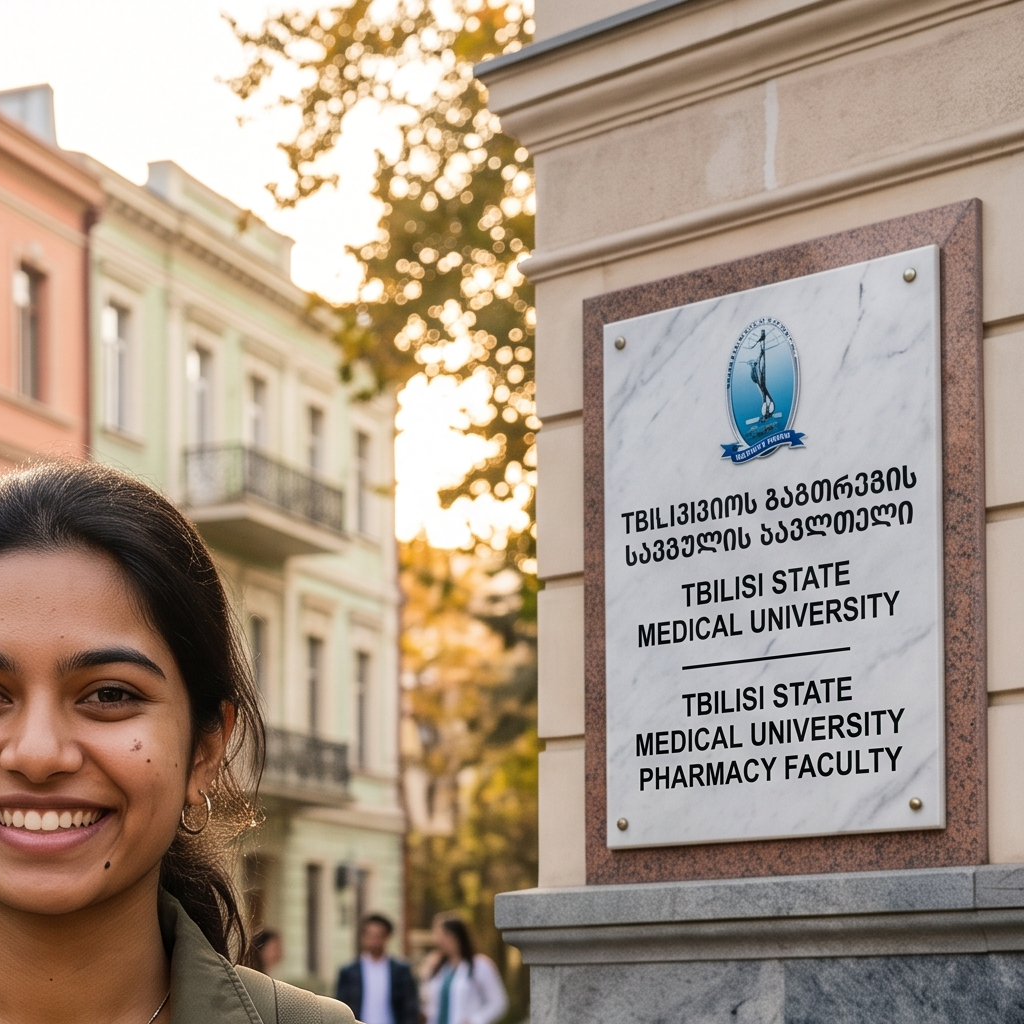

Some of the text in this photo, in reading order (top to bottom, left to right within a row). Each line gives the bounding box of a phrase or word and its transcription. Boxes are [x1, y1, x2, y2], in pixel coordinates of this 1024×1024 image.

[682, 560, 850, 607] TBILISI STATE
[639, 591, 899, 647] MEDICAL UNIVERSITY
[682, 676, 852, 717] TBILISI STATE
[636, 708, 905, 756] MEDICAL UNIVERSITY
[640, 746, 902, 791] PHARMACY FACULTY
